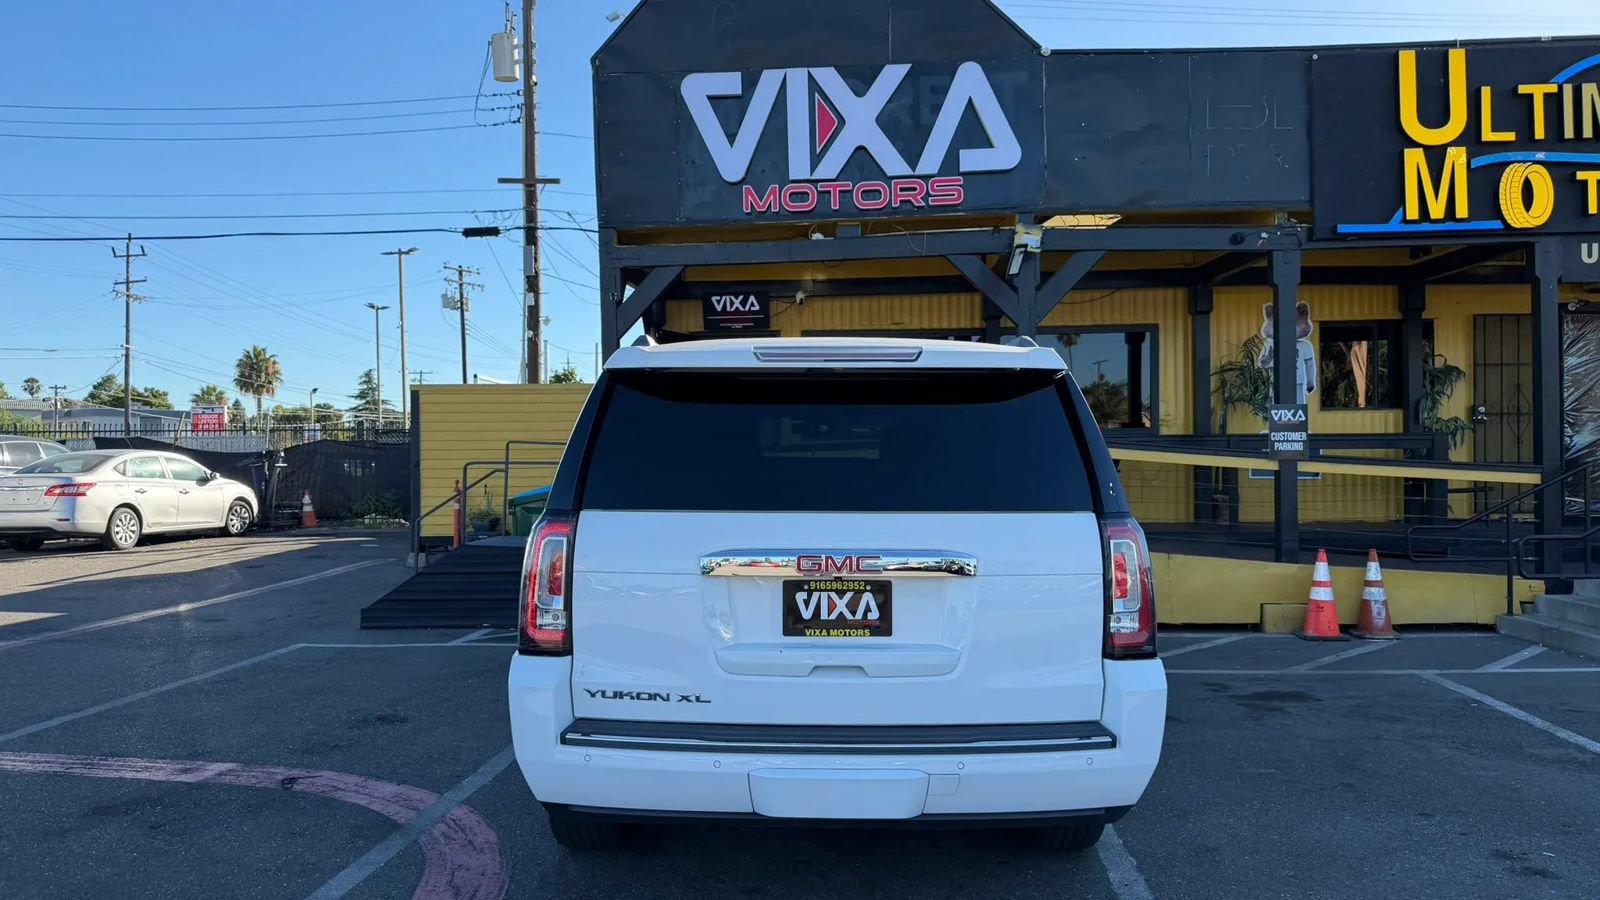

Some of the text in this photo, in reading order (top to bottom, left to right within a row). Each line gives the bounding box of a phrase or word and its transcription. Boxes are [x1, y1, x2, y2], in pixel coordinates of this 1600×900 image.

[681, 61, 1022, 183] VIXA
[742, 176, 964, 213] MOTORS
[711, 294, 760, 312] VIXA
[1270, 409, 1306, 421] VIXA
[1270, 431, 1307, 441] CUSTOMER
[1274, 441, 1304, 451] PARKING
[794, 555, 885, 575] GMC
[810, 581, 865, 590] 9165962952
[794, 591, 880, 620] VIXA
[804, 628, 871, 636] VIXA MOTORS
[583, 688, 712, 704] YUKON XL
